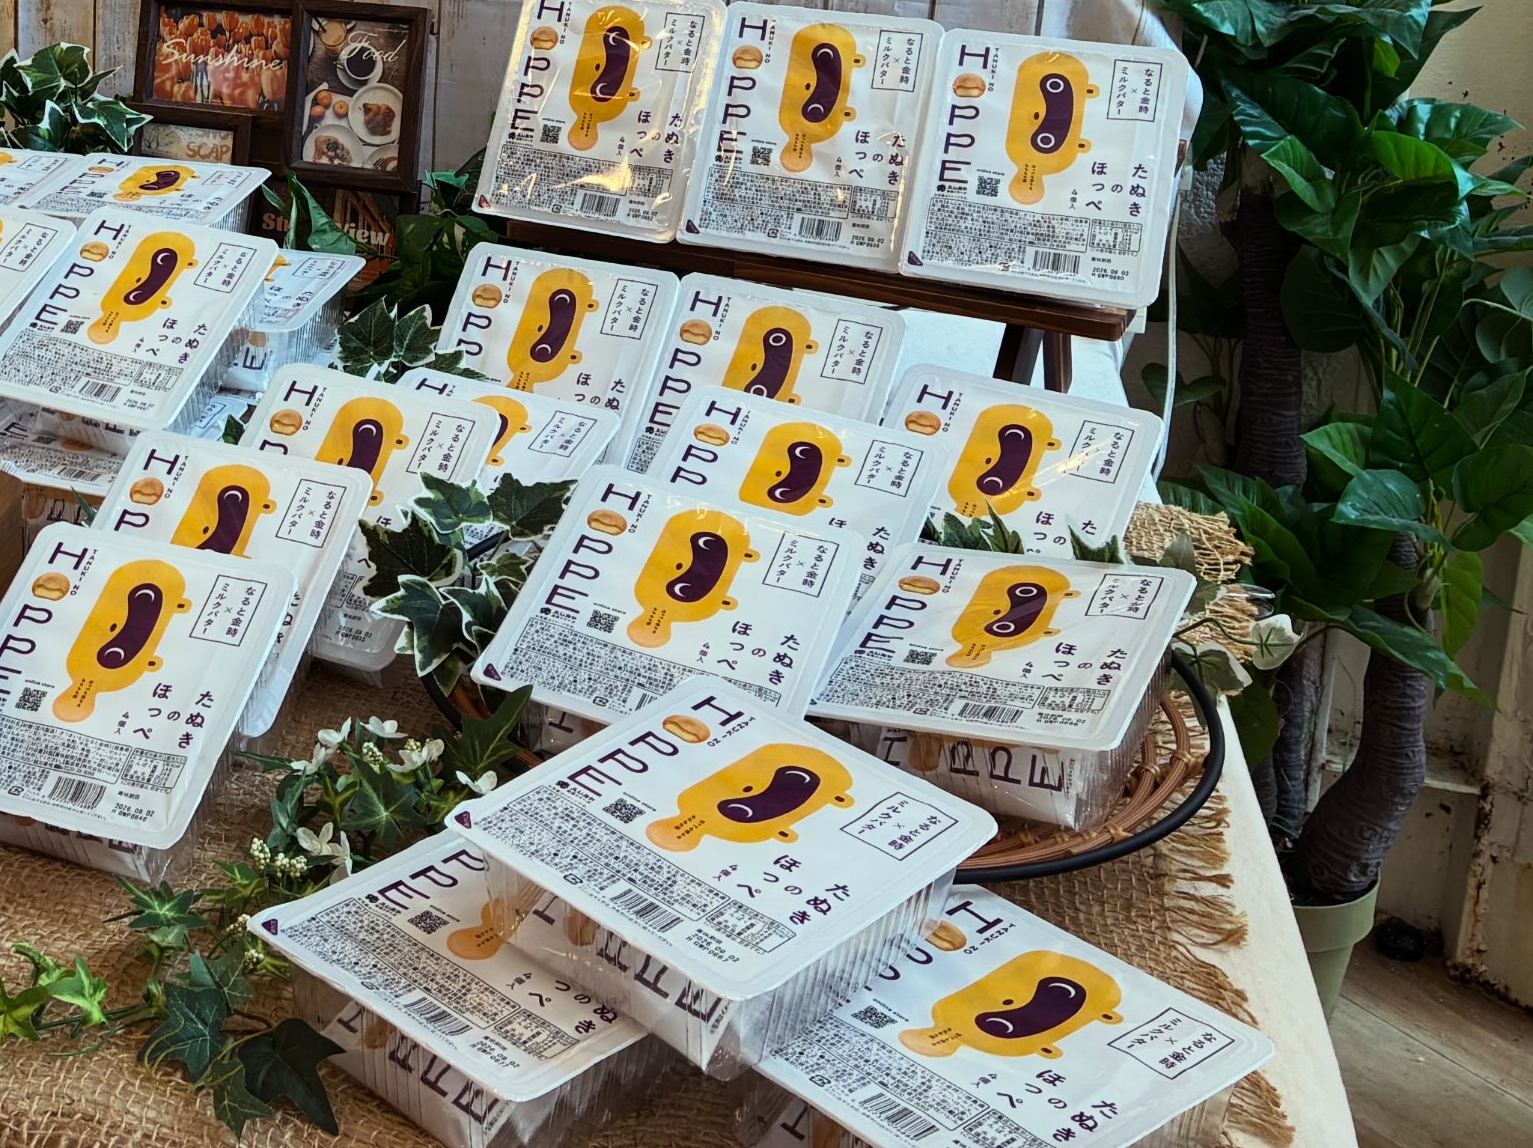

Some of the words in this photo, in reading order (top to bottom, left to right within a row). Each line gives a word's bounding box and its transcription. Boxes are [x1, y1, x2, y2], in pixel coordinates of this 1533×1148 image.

[161, 38, 285, 70] Sunshine
[341, 30, 407, 63] Food
[663, 19, 677, 66] ミルクバター
[680, 20, 698, 65] なると金時
[879, 36, 893, 85] ミルクバター
[900, 37, 916, 84] なると金時
[1116, 67, 1129, 115] ミルクバター
[1138, 68, 1155, 114] なると金時
[663, 114, 683, 163] たぬき
[887, 134, 906, 185] たぬき
[1110, 184, 1124, 194] の
[1128, 163, 1148, 217] たぬき
[610, 285, 627, 331] ミルクバター
[629, 288, 650, 332] なると金時
[717, 297, 731, 328] TANUKI
[830, 326, 849, 375] ミルクバター
[851, 331, 874, 376] なると金時
[309, 387, 327, 418] TANUKI
[417, 420, 442, 470] ミルクバター
[437, 423, 466, 473] なると金時
[1076, 428, 1095, 471] ミルクー
[172, 455, 188, 487] TANUKI
[287, 486, 313, 535] ミルクバター
[310, 490, 337, 540] なると金時
[635, 494, 652, 522] TANUKI
[79, 548, 98, 582] TANUKI
[863, 526, 890, 570] たぬき
[201, 583, 230, 634] ミルクバター
[225, 586, 257, 637] なると金時
[752, 647, 766, 657] の
[768, 634, 801, 686] たぬき
[1097, 648, 1127, 686] たぬき
[167, 710, 181, 722] の
[178, 691, 214, 749] たぬき
[722, 716, 756, 739] TANUKI
[784, 885, 802, 895] の
[789, 883, 851, 926] たぬき
[1046, 1097, 1067, 1110] の
[1052, 1100, 1119, 1142] たぬき
